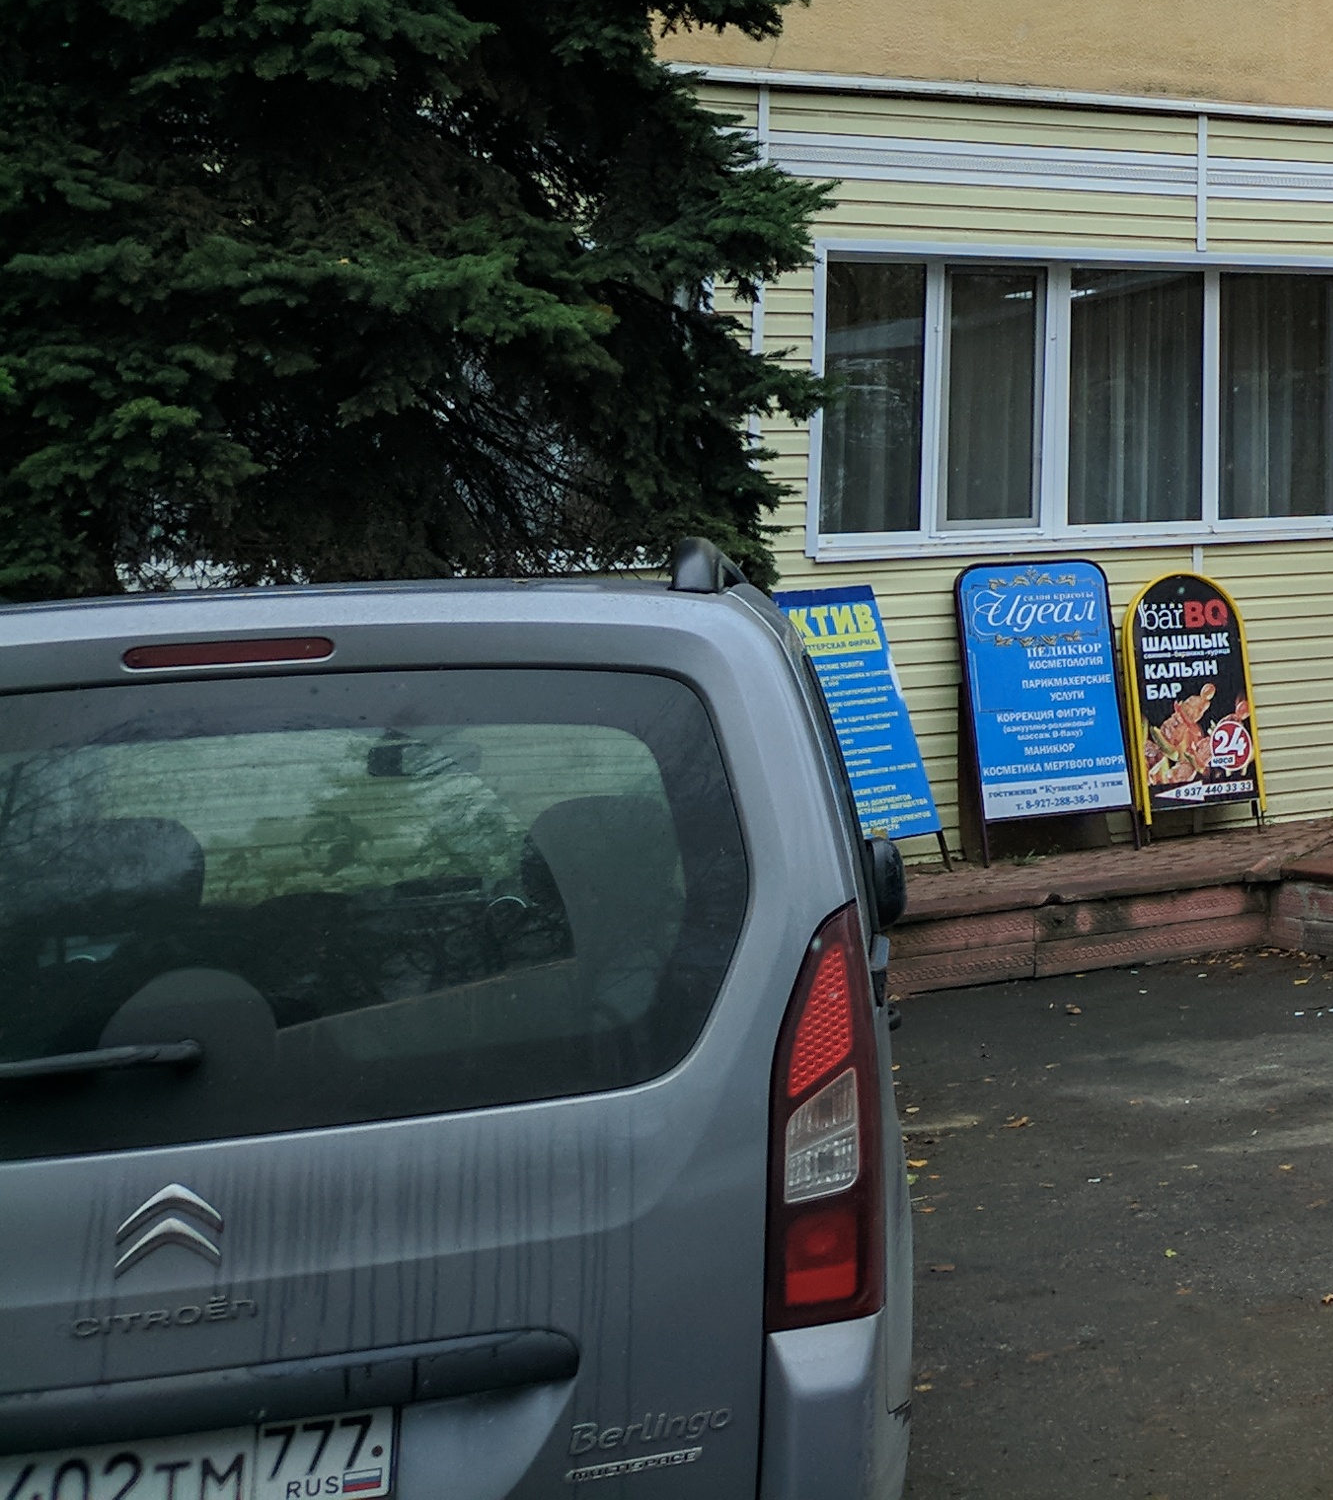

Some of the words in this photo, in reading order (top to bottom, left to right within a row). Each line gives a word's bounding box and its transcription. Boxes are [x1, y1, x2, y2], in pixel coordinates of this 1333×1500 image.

[1023, 594, 1051, 602] салон
[1053, 592, 1094, 601] красоты
[972, 590, 1096, 636] Идеал
[848, 638, 877, 647] ФИРМА
[1027, 642, 1102, 658] ПЕДИКЮР
[1141, 632, 1230, 652] ШАШЛЫК
[1029, 656, 1104, 670] КОСМЕТОЛОГИЯ
[1144, 660, 1218, 680] КАЛЬЯН
[1022, 673, 1112, 689] ПАРИКМАХЕРСКИЕ
[1050, 690, 1085, 702] УСЛУГИ
[1145, 682, 1182, 701] БАР
[997, 709, 1054, 723] КОРРЕКЦИЯ
[1056, 707, 1096, 719] ФИГУРЫ
[1017, 732, 1050, 741] массаж
[1214, 727, 1247, 756] 24
[1024, 743, 1075, 756] МАНИКЮР
[983, 763, 1042, 777] КОСМЕТИКА
[1044, 758, 1094, 771] МЕРТВОГО
[1096, 754, 1125, 767] МОРЯ
[1213, 756, 1234, 765] часа
[988, 788, 1037, 799] гостиница
[1101, 779, 1123, 788] этаж
[1175, 790, 1181, 798] 8
[1184, 787, 1202, 796] 937
[1205, 784, 1223, 793] 440
[1226, 783, 1237, 792] 33
[1240, 782, 1251, 791] 33
[1015, 802, 1024, 810] т.
[567, 1407, 733, 1456] Berlingo
[264, 1415, 373, 1481] 777
[572, 1450, 697, 1481] MULTISPACE
[286, 1475, 339, 1500] RUS
